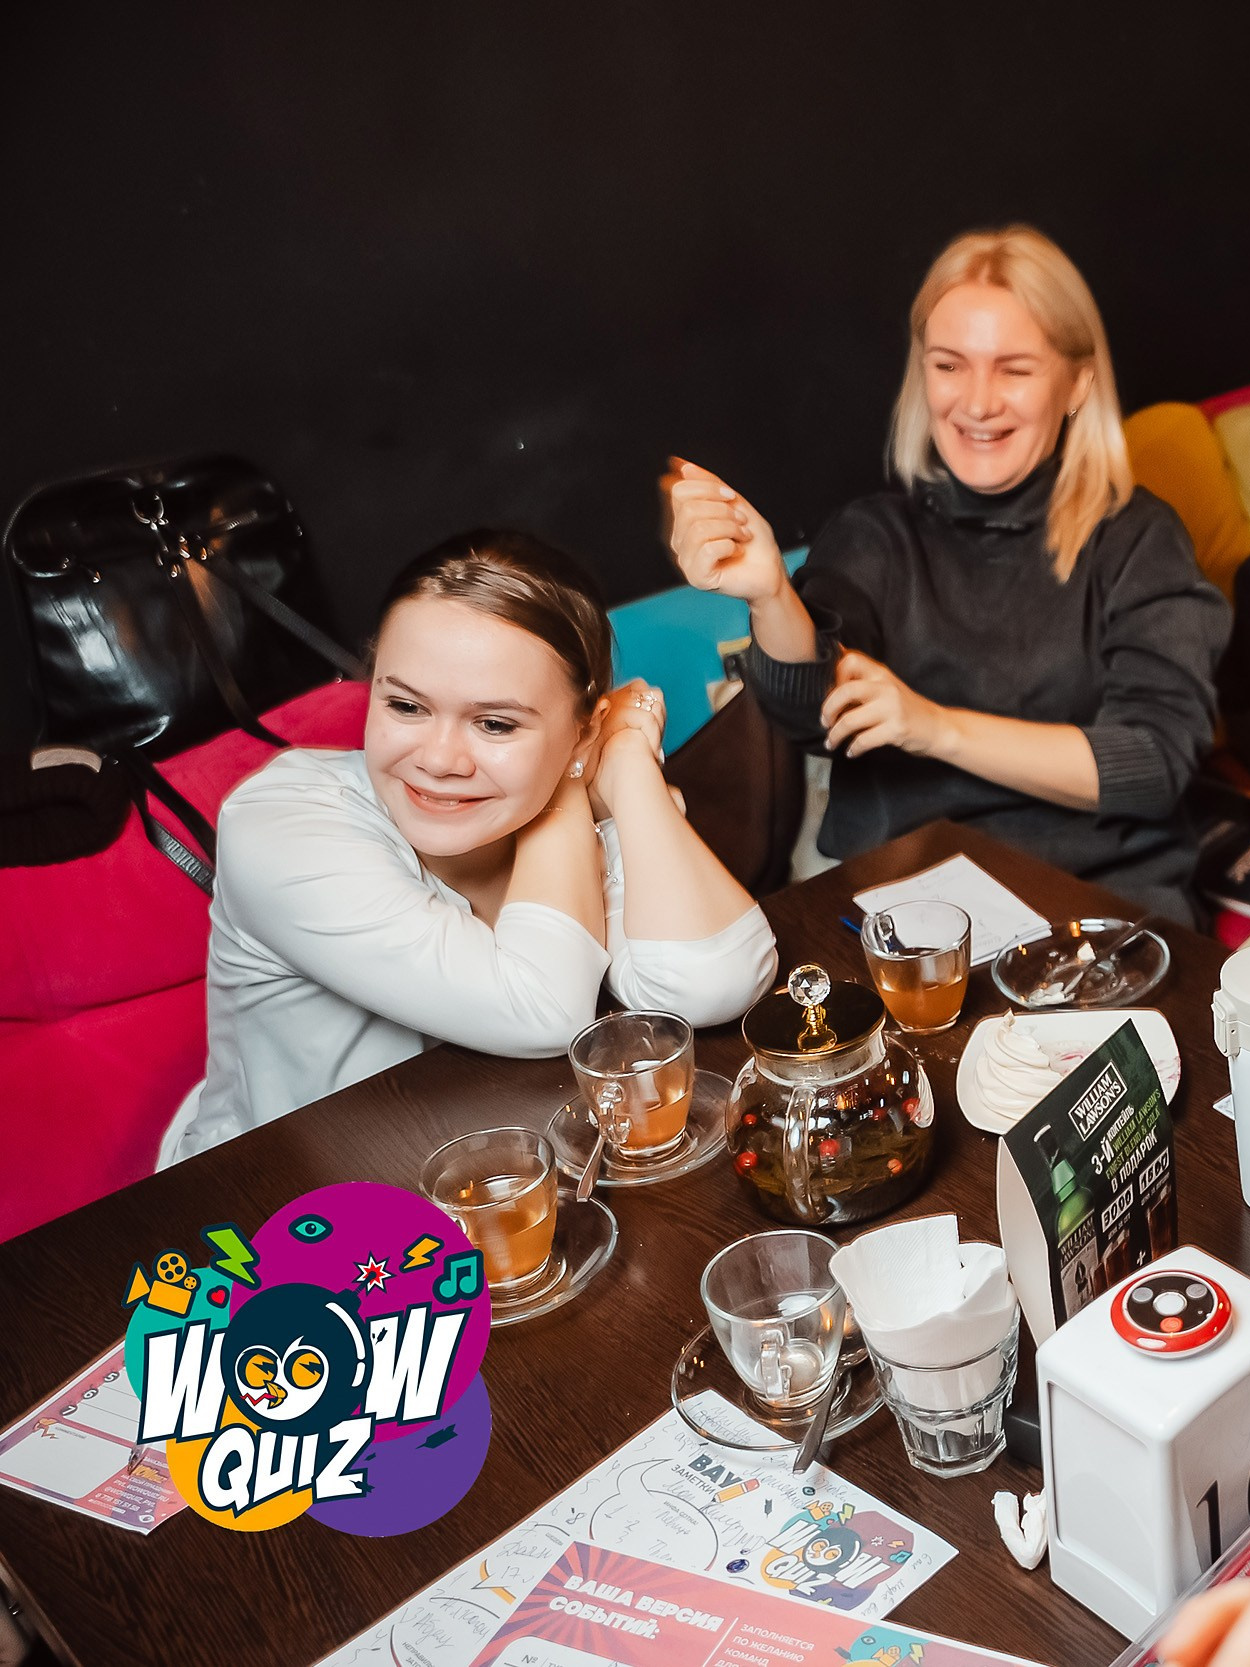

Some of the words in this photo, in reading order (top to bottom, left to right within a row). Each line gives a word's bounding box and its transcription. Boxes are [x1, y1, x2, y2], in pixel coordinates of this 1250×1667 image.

[1074, 1070, 1114, 1119] WILLIAM
[1079, 1081, 1122, 1135] LAWSON'S
[1119, 1125, 1158, 1184] ПОДАРОК
[671, 1464, 716, 1495] ЗАМЕТКИ
[765, 1554, 836, 1596] QUIZ
[549, 1596, 660, 1639] СОБЫТИЙ:
[564, 1575, 635, 1606] ВАША
[635, 1596, 724, 1632] ВЕРСИЯ
[725, 1648, 769, 1667] КОМАНД
[732, 1636, 749, 1646] ПО
[749, 1641, 805, 1662] ЖЕЛАНИЮ
[740, 1624, 815, 1651] ЗАПОЛНЯЕТСЯ
